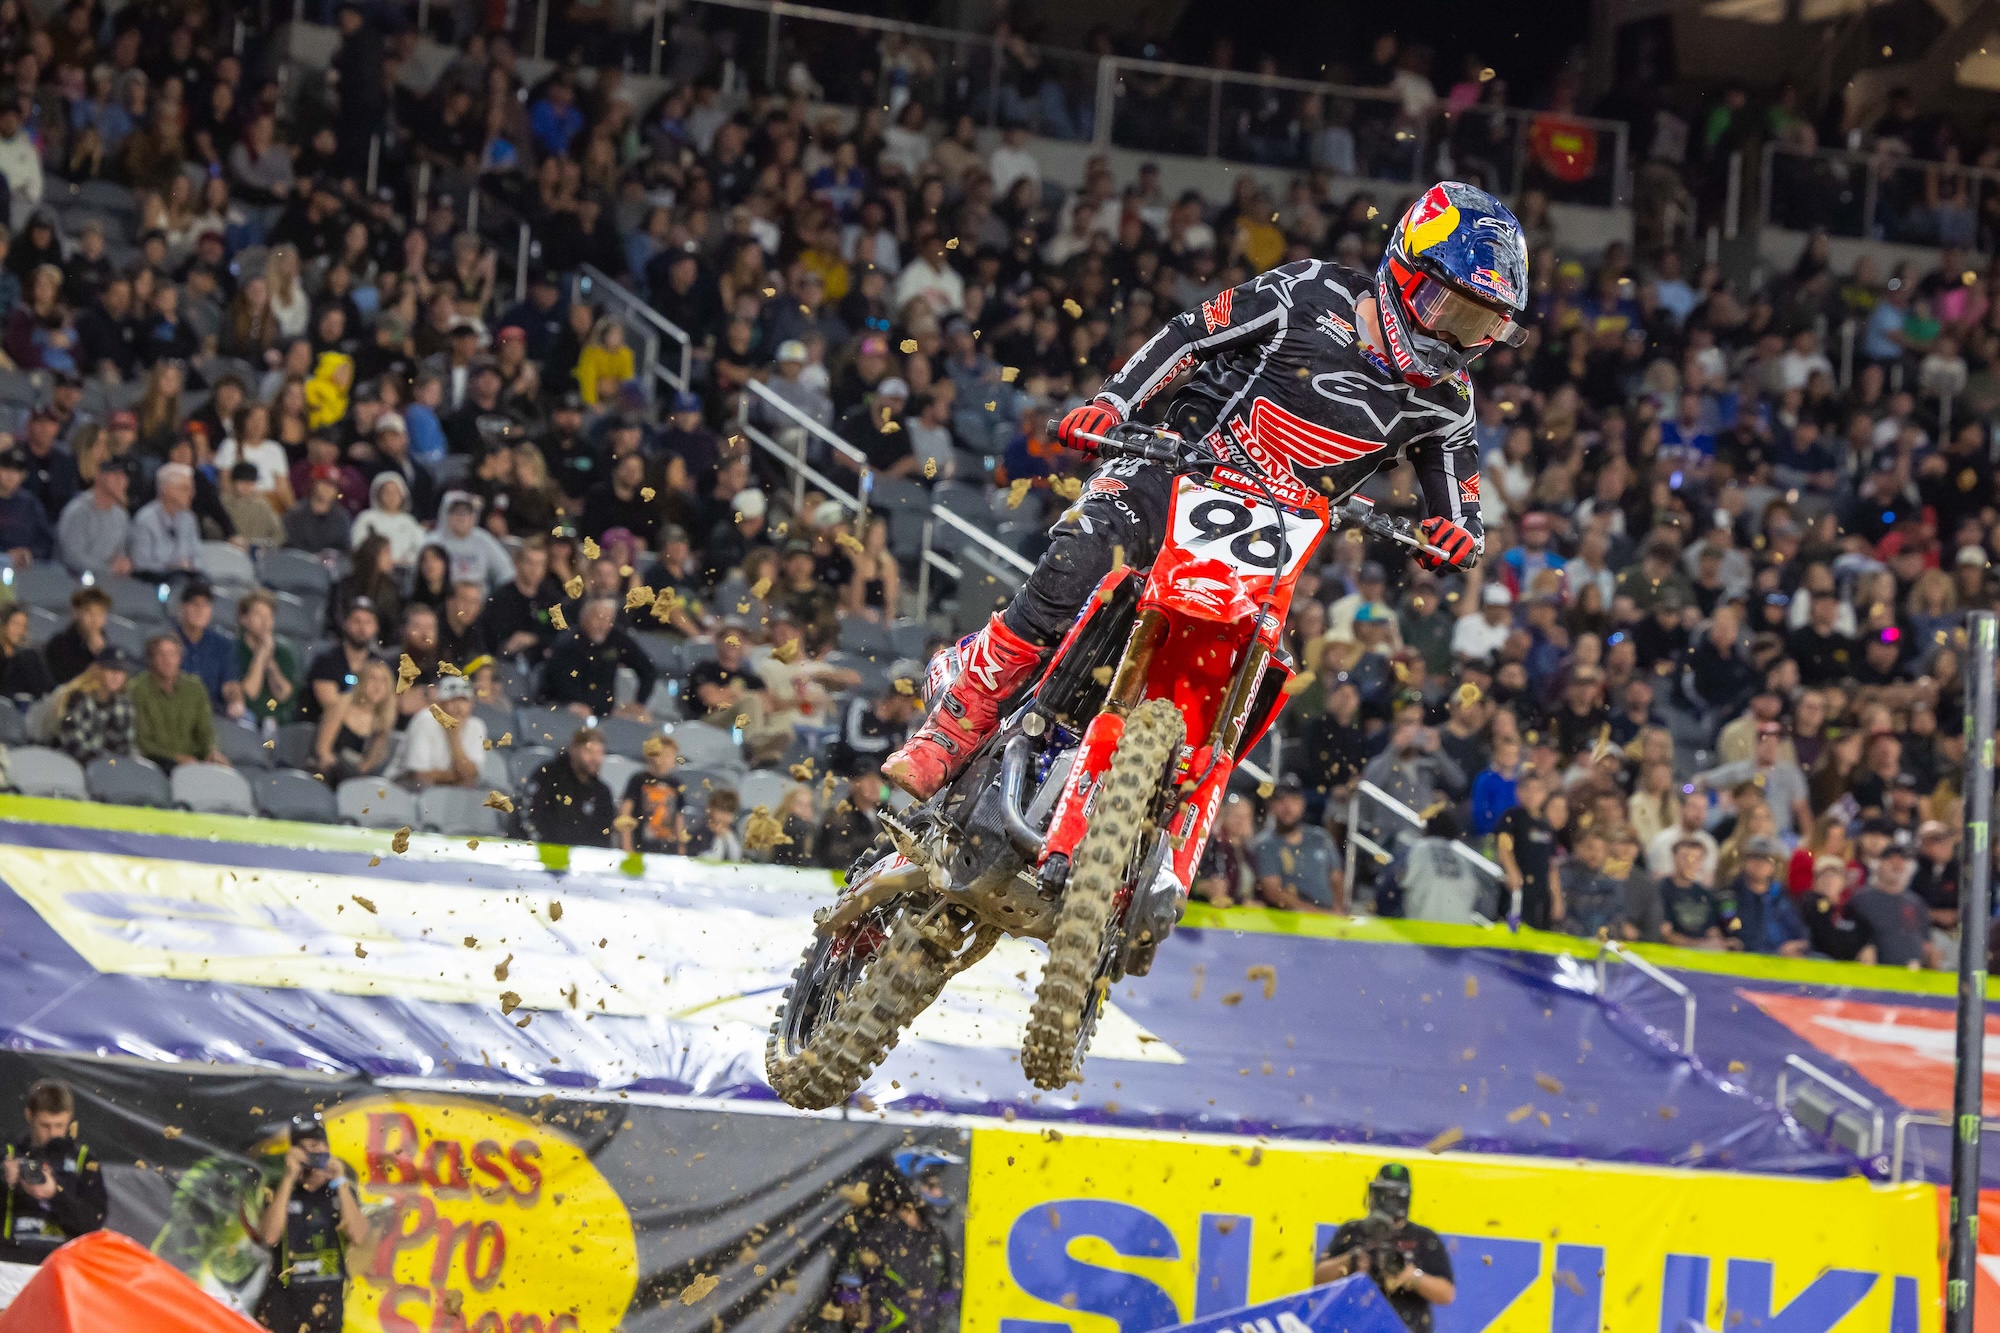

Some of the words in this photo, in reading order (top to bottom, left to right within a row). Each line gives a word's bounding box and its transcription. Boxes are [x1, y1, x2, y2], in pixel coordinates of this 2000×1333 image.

[1379, 281, 1397, 330] Red
[1471, 273, 1495, 290] Red
[1495, 283, 1517, 302] Bull
[1386, 323, 1413, 371] Bull
[1189, 499, 1293, 569] 96
[1052, 745, 1091, 832] DUNLOP
[1188, 784, 1221, 881] DUNLOP
[365, 1112, 543, 1204] Bass
[368, 1194, 506, 1291] Pro
